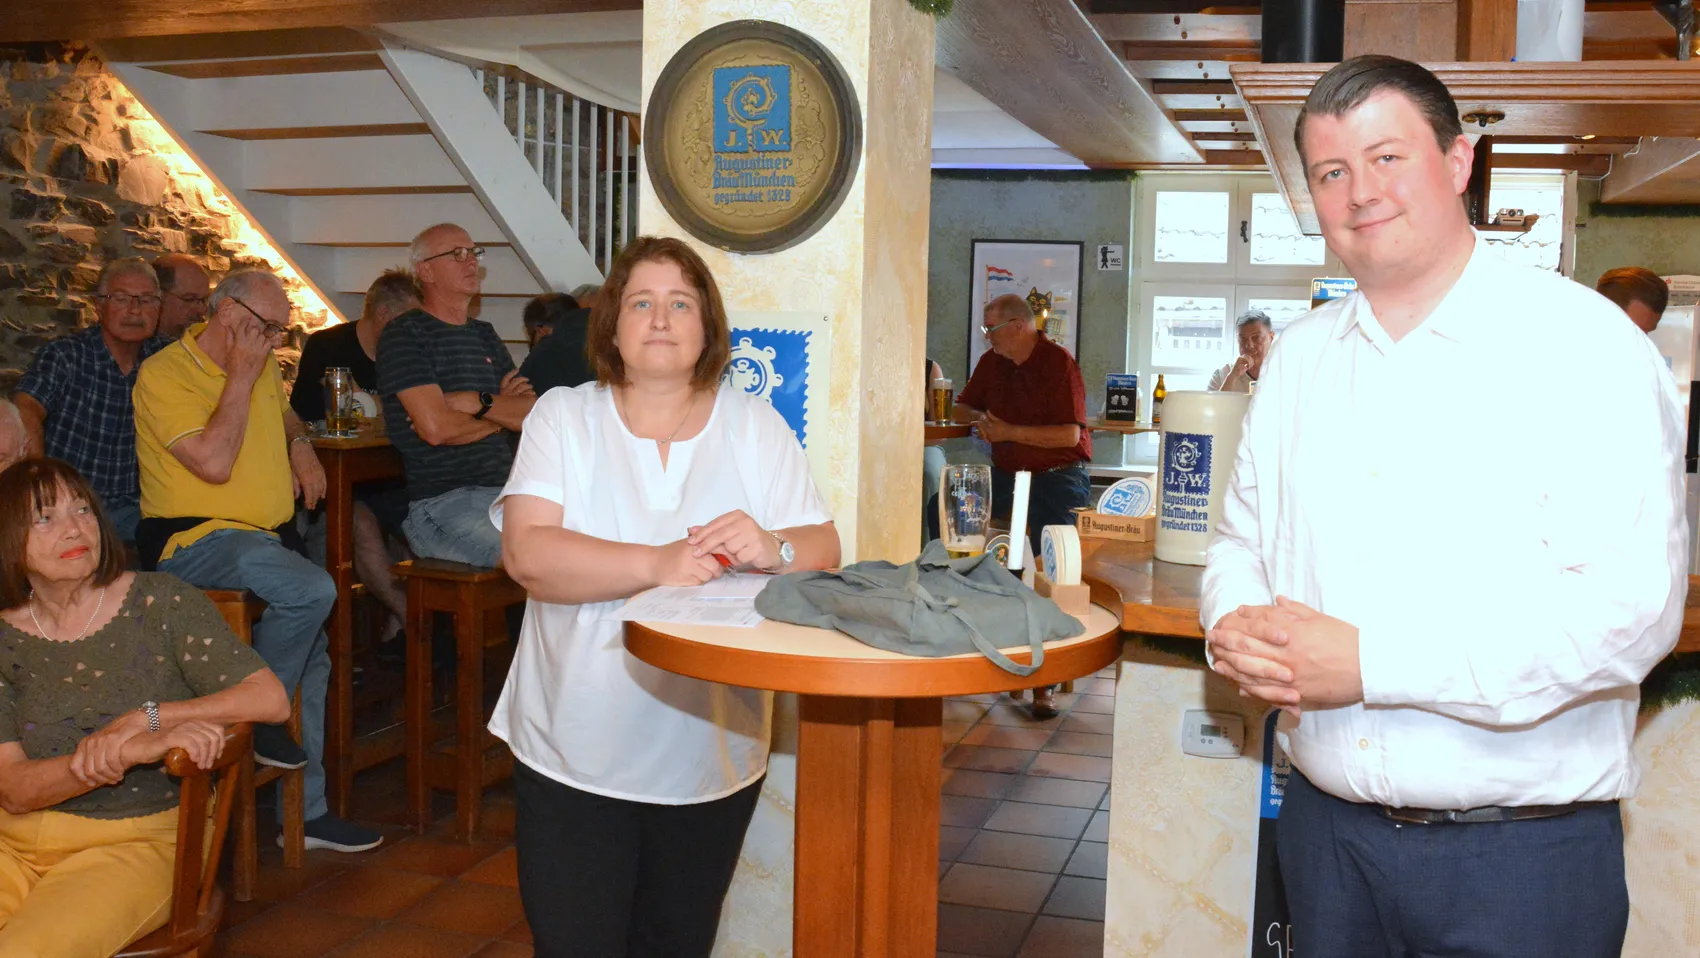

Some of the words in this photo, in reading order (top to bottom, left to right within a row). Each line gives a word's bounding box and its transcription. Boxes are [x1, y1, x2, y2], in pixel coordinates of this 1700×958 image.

[761, 129, 787, 145] W.
[714, 190, 763, 205] gegründet
[766, 189, 791, 203] 1328
[1187, 472, 1207, 487] W.
[1190, 522, 1208, 533] 1328
